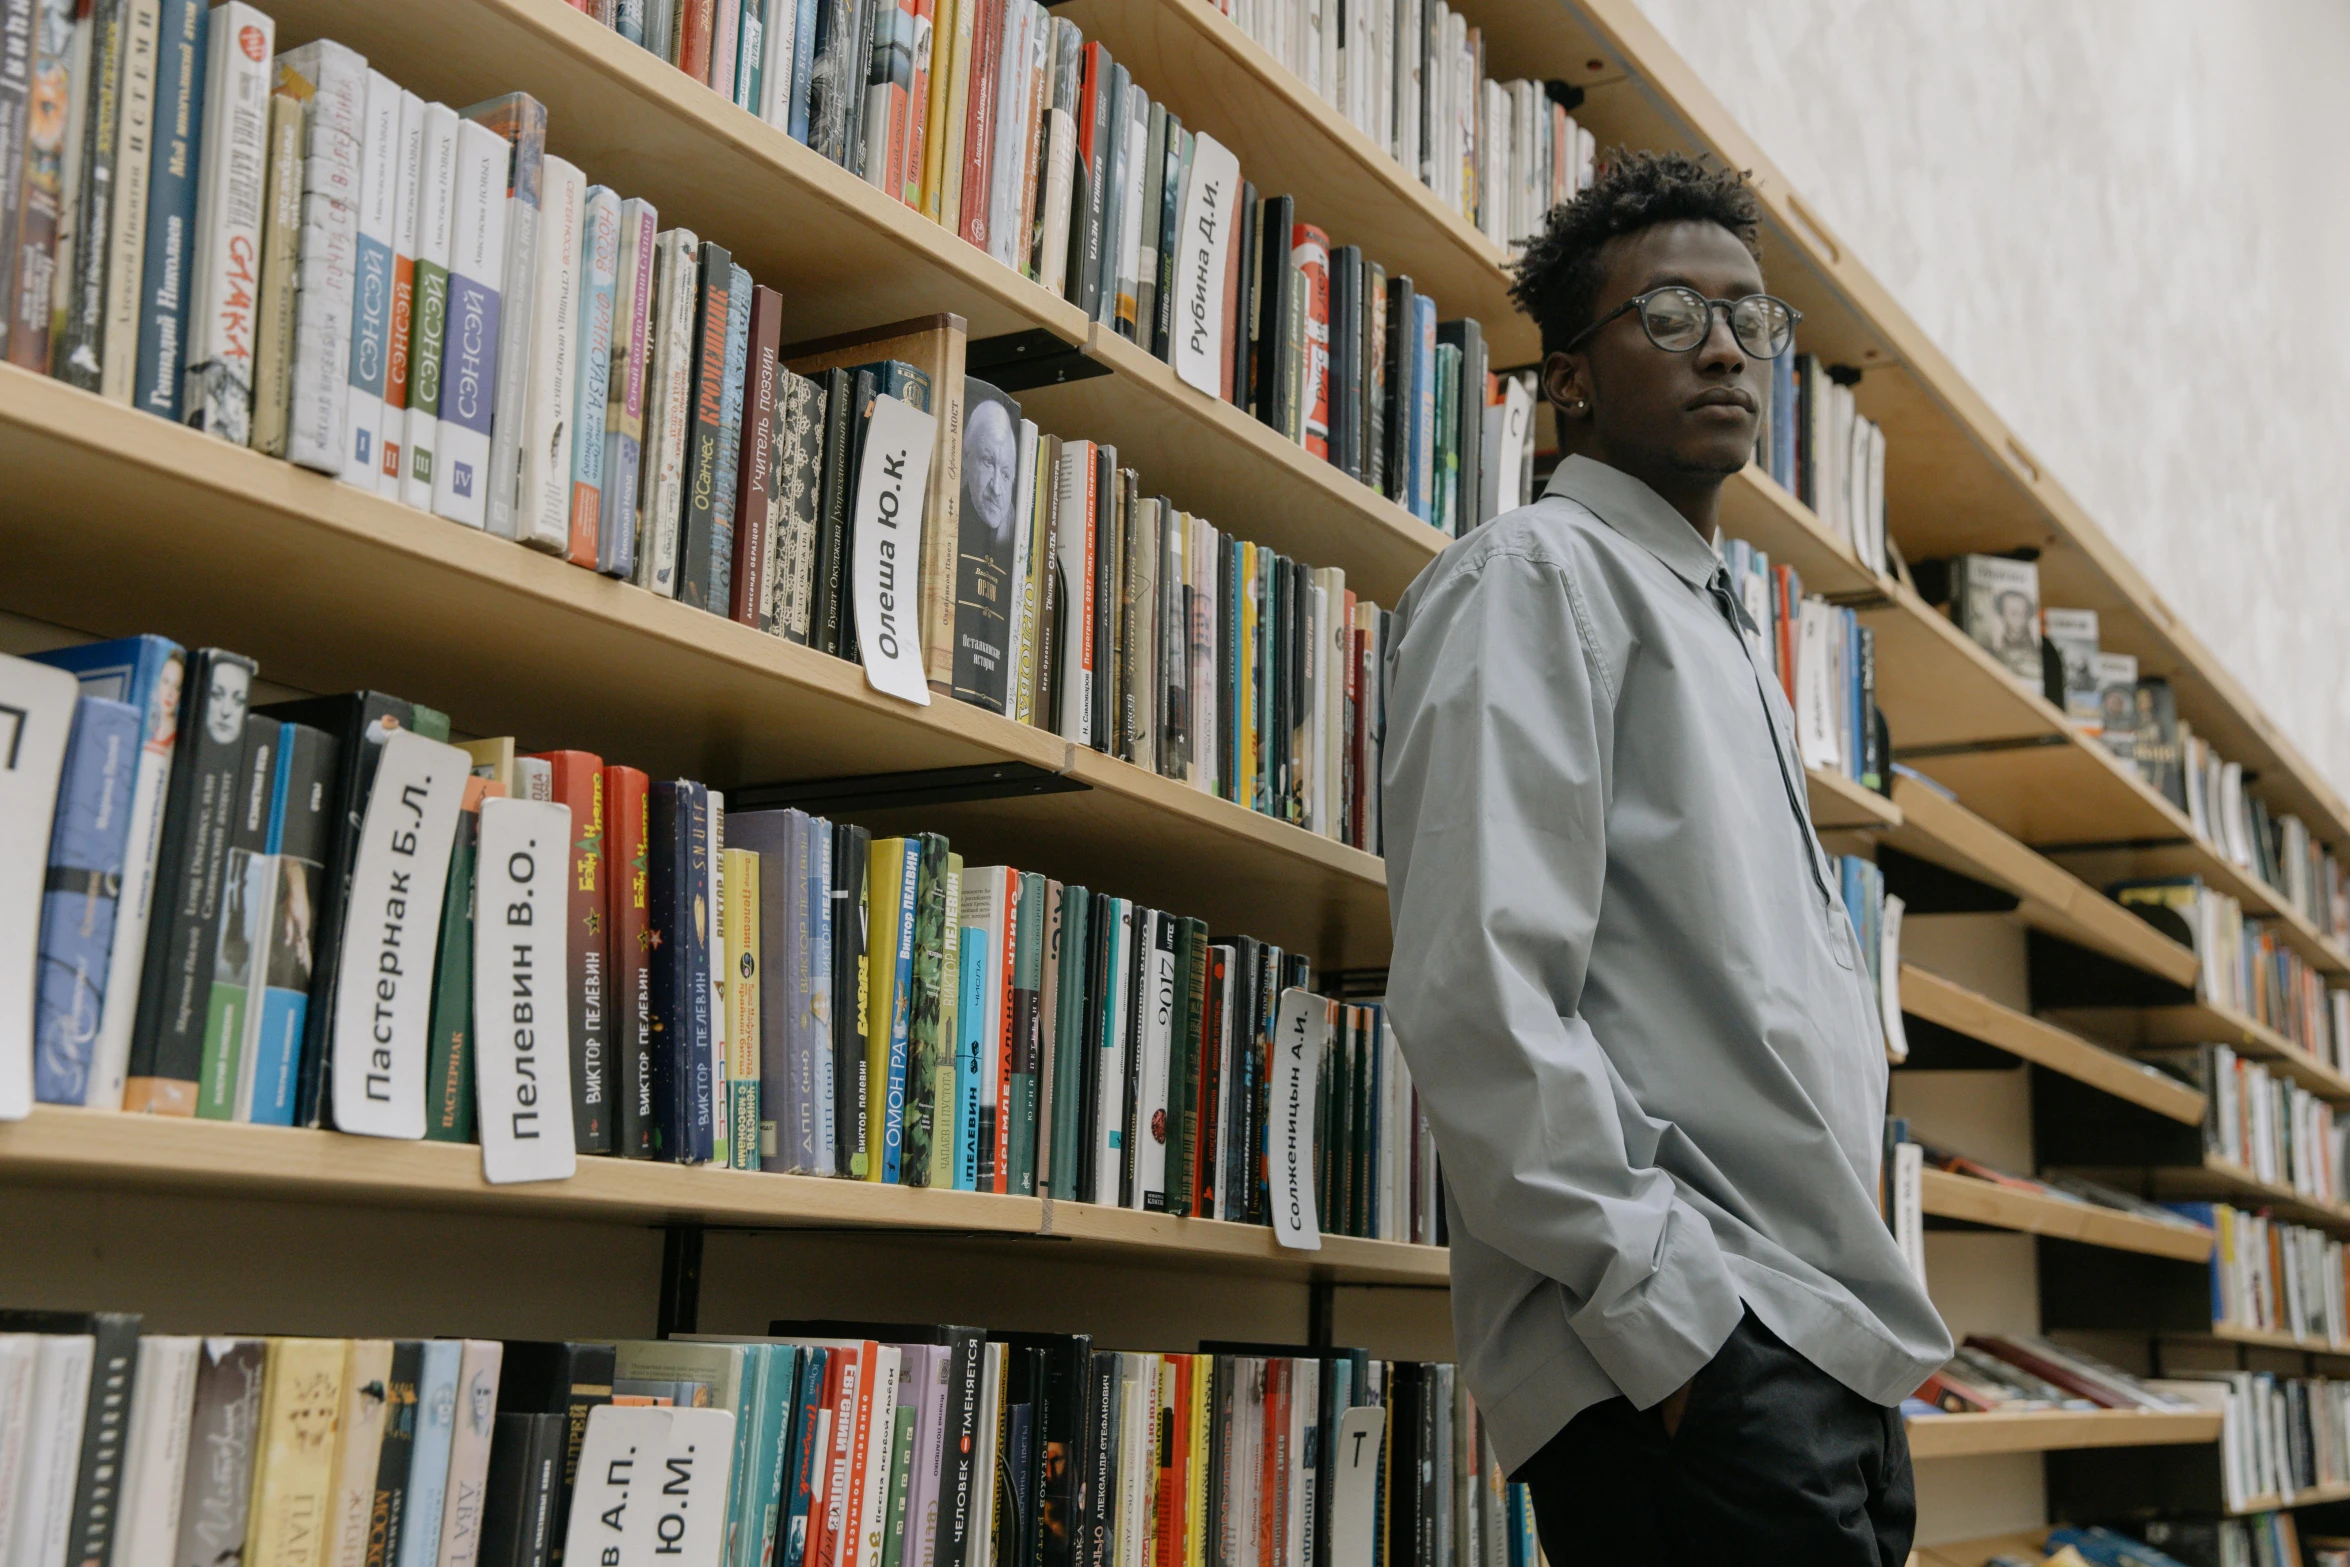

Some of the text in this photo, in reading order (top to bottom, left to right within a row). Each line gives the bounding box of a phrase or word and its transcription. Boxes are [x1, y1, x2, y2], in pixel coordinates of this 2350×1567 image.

[781, 57, 792, 107] Марина
[867, 1, 878, 77] Татьяна Москвина
[373, 107, 390, 225] Анастасия НОВЫХ
[893, 149, 901, 170] БАЙ
[974, 78, 988, 168] Алексей Моторов
[404, 127, 421, 244] Анастасия НОВЫХ
[434, 135, 451, 251] Анастасия НОВЫХ
[474, 154, 491, 268] Анастасия НОВЫХ
[595, 205, 615, 273] НОСОВ
[1090, 155, 1103, 260] ВЕЛИКАЯ МЕЧТА
[117, 164, 141, 327] Алексей Никитин
[217, 235, 256, 358] САМКА
[552, 179, 576, 418] СЕРГЕЙ НОСОВ СТРАНИЦА НОМЕР ШЕСТЬ
[1191, 180, 1219, 356] Рубина Д.И.
[149, 214, 183, 409] Геннадий Николаев
[356, 249, 384, 382] СЭНСЭЙ
[391, 283, 412, 385] СЭНСЭЙ
[414, 274, 444, 403] СЭНСЭЙ
[457, 288, 486, 420] СЭНСЭЙ
[586, 291, 611, 411] ФРАНСУАЗА,
[628, 218, 653, 413] СЕРЫЙ ИМЕНИ СТЕПАН
[694, 284, 729, 511] О'Санчес КРОМЕШНИК
[582, 425, 595, 480] леднику
[746, 345, 775, 620] Александр ОБРАЗЦОВ УЧИТЕЛЬ ПОЭЗИИ
[827, 382, 849, 630] Булат Окуджава Упраздненный театр
[1088, 448, 1097, 498] Омфалоса
[619, 474, 634, 561] Николай Норд
[763, 511, 775, 607] БУЛАТ ОКУДЖАВА
[877, 449, 907, 661] Олеша Ю.К.
[942, 399, 959, 626] Олейников Павел МОСТ
[1087, 500, 1096, 529] Тайна
[796, 531, 809, 624] БУЛАТ ОКУДЖАВА
[977, 577, 997, 602] ОРЛОВ
[1041, 459, 1061, 692] Вера Орловская СИЛЫ электричества
[1085, 578, 1094, 603] 2027
[1018, 581, 1035, 720] ОРЛОВА
[1083, 614, 1094, 666] Петроград
[1304, 615, 1314, 680] ФЛОГИСТОН
[1081, 725, 1089, 736] Н.
[1082, 673, 1092, 724] Самоваров
[182, 877, 203, 916] Long
[715, 807, 725, 939] ВИКТОР ПЕЛЕВИН
[743, 857, 755, 949] Виктор Пелевин
[799, 831, 810, 995] ВИКТОР ПЕЛЕВИН
[944, 871, 960, 952] ПЕЛЕВИН
[174, 925, 201, 1034] Марина Палей
[365, 774, 432, 1104] Пастернак Б.Л.
[506, 838, 541, 1141] Пелевин В.О.
[943, 953, 957, 1008] ВИКТОР
[973, 959, 983, 1007] ЧИСЛА
[1157, 955, 1175, 1026] 2017
[584, 951, 602, 1105] ВИКТОР ПЕЛЕВИН
[637, 967, 651, 1117] ВИКТОР ПЕЛЕВИН
[695, 972, 710, 1126] ВИКТОР ПЕЛЕВИН
[821, 837, 836, 1156] ДПП ВИКТОР ПЕЛЕВИН
[857, 953, 869, 1039] EMPIRE
[886, 849, 919, 1148] ОМОН РА Виктор ПЕЛЕВИН
[999, 889, 1019, 1176] КРЕМЛЕНАЛЬНОЕ ЧТИВО
[1027, 885, 1042, 1122] ЮРИЙ ПЕТКЕВИЧ КОЛЕСО ОБОЗРЕНИЯ
[1135, 923, 1150, 1073] Ольга Славникова
[1260, 997, 1269, 1027] ВИКТОР
[442, 1030, 464, 1129] ПАСТЕРНАК
[736, 1095, 749, 1168] масонами
[746, 1084, 758, 1150] чекистов
[857, 1059, 868, 1154] виктор пелевин
[940, 1071, 953, 1117] ПУСТОТА
[1208, 999, 1222, 1163] АЛЕКСЕЙ СМИРНОВ ХИЩНАЯ ОТТЕПЕЛЬ
[1286, 1010, 1309, 1232] Солженицын А.И.
[938, 1131, 952, 1173] ЧАПАЕВ
[808, 1362, 819, 1395] Юрий
[834, 1363, 858, 1451] ЕВГЕНИЙ
[846, 1394, 870, 1557] Безумное плавание
[874, 1368, 896, 1525] Песня первой любви
[933, 1393, 945, 1477] Игнатий ПОТАПЕНКО
[1039, 1450, 1049, 1509] СТАХОВ
[1096, 1374, 1111, 1520] АЛЕКСАНДР СТЕФАНОВИЧ
[1352, 1431, 1368, 1468] Т
[601, 1446, 637, 1534] А.П.
[655, 1445, 696, 1556] Ю.М.
[953, 1459, 969, 1543] ЧЕЛОВЕК
